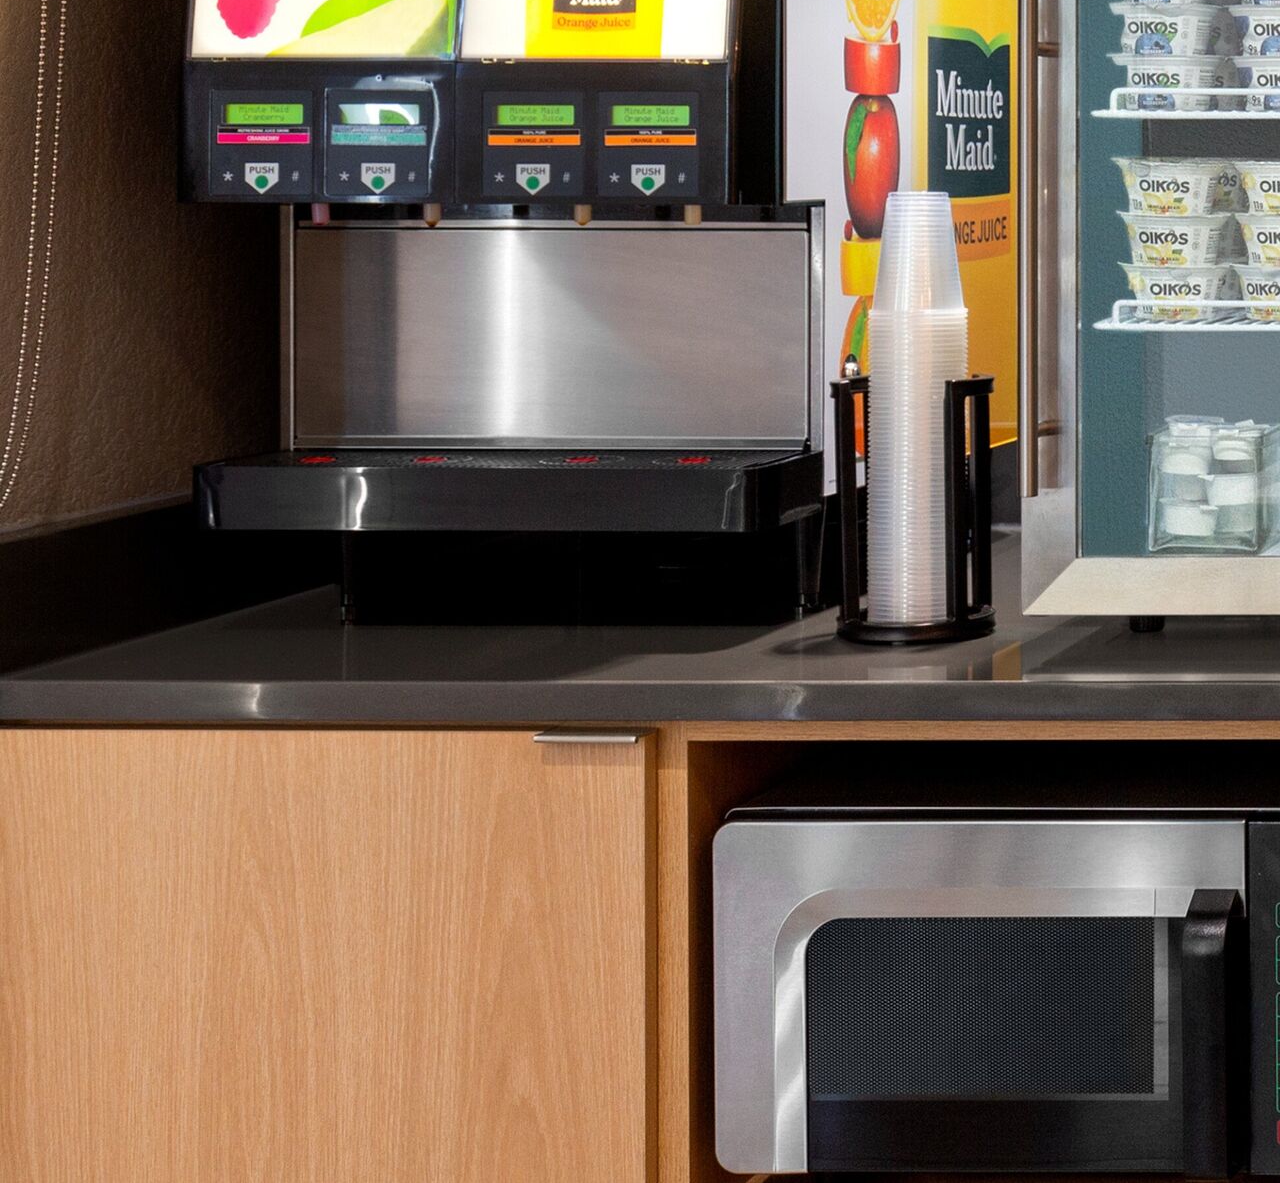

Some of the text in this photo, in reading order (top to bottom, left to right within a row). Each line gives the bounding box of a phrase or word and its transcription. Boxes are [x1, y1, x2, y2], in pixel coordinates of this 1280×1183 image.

[557, 16, 631, 30] Orange Juice
[1128, 21, 1178, 34] OIKOS
[1131, 72, 1180, 85] OIKOS
[936, 69, 1003, 119] Minute
[945, 124, 995, 171] Maid
[249, 166, 275, 174] PUSH
[365, 166, 391, 174] PUSH
[635, 168, 661, 176] PUSH
[1139, 179, 1190, 193] OIKOS
[954, 217, 1007, 244] NGE JUICE
[1139, 231, 1188, 245] OIKOS
[1150, 283, 1201, 297] OIKOS
